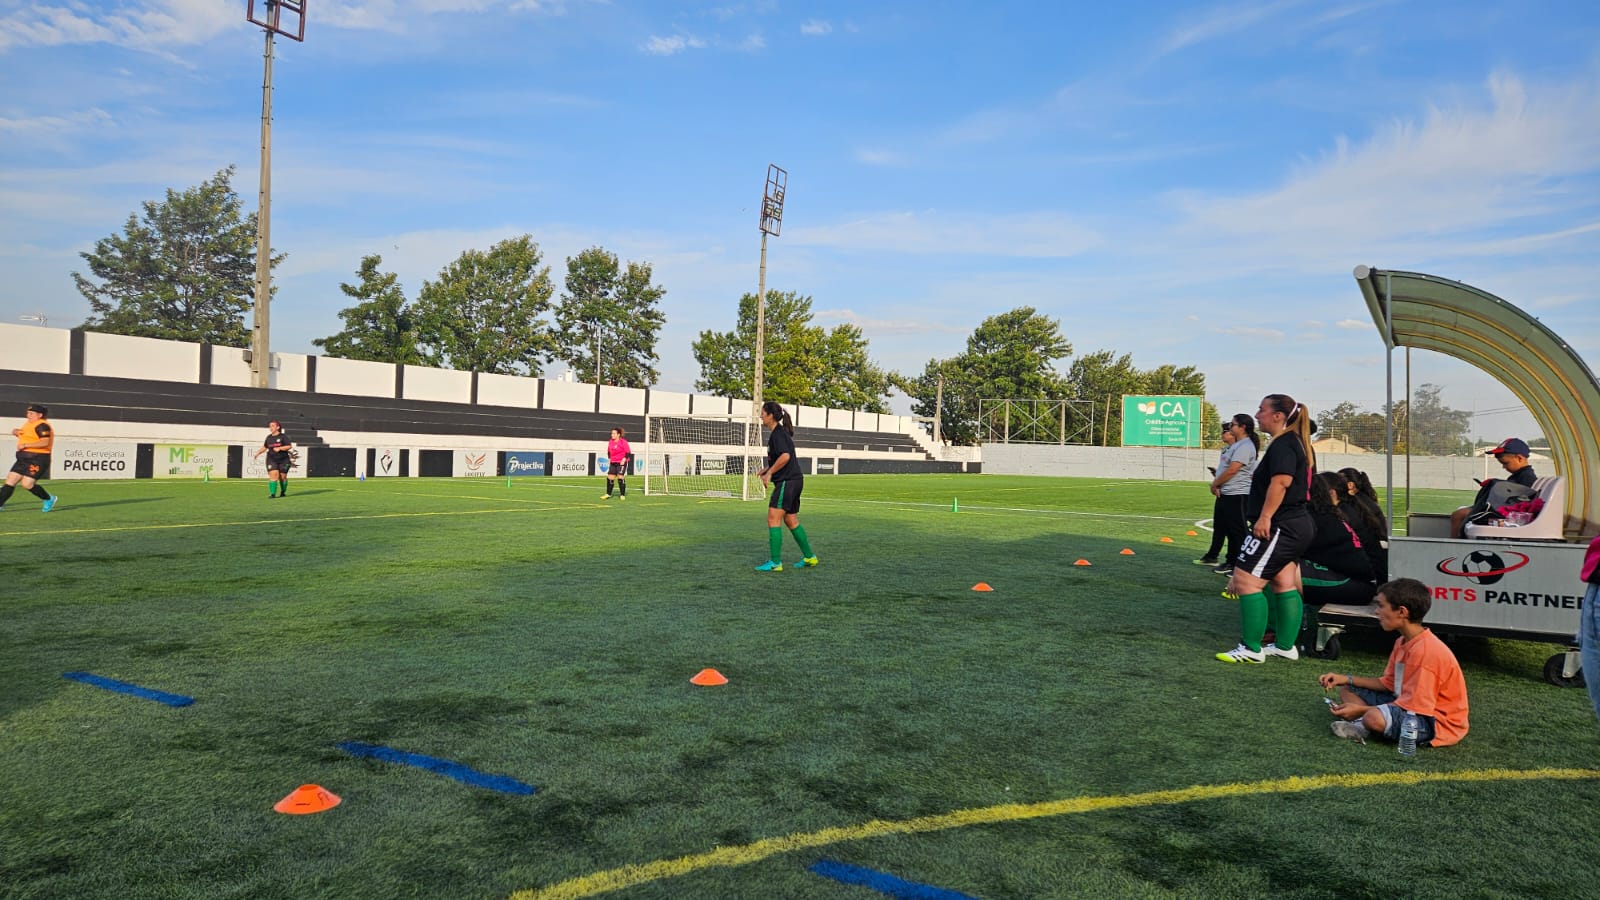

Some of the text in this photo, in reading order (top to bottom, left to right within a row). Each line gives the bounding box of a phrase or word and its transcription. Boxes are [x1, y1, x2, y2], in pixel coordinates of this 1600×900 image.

[1160, 401, 1185, 417] CA
[86, 450, 125, 459] Cervejaria
[169, 448, 213, 465] MF Grupo
[63, 459, 126, 471] PACHECO
[508, 458, 544, 473] Projectiva
[1240, 535, 1261, 555] 99
